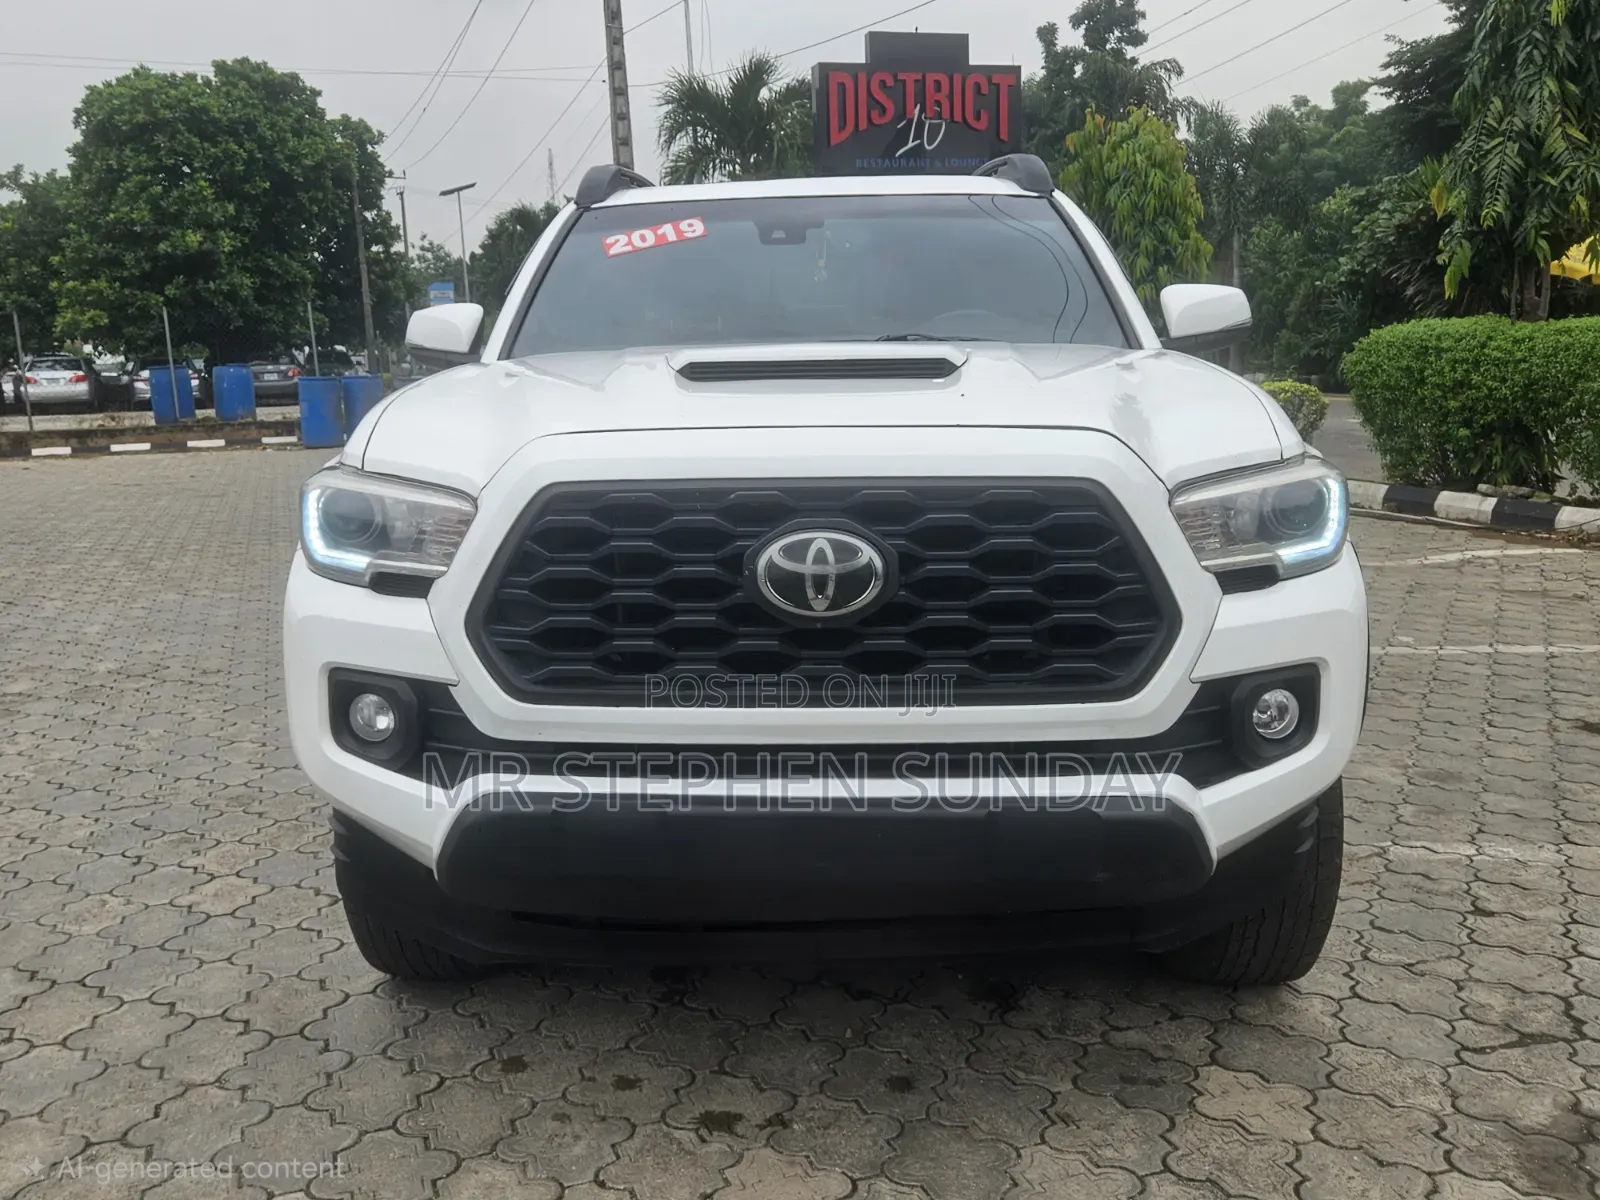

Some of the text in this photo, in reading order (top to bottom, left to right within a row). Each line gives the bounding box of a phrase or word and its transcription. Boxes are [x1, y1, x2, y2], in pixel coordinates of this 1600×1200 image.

[828, 71, 1017, 147] DISTRICT
[855, 158, 931, 168] RESTAURANT
[605, 218, 705, 256] 2019
